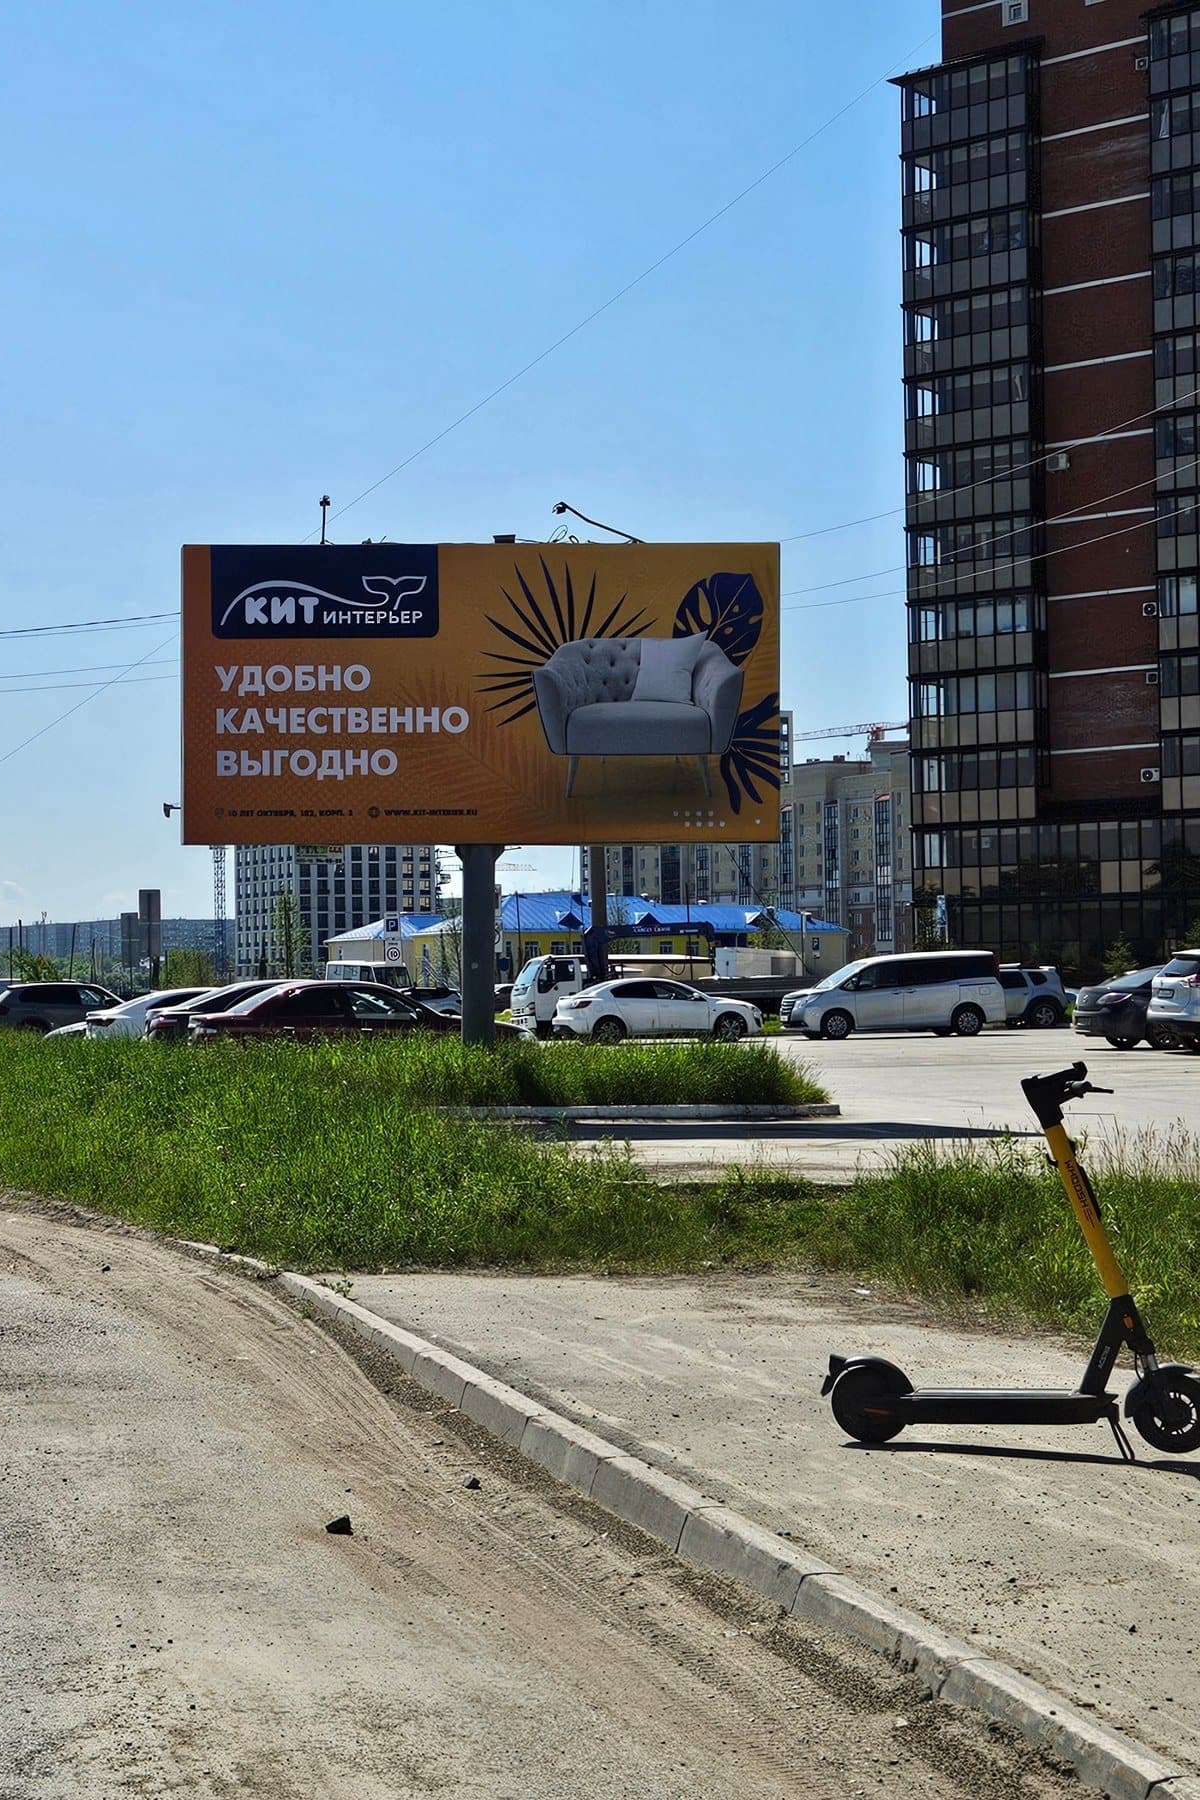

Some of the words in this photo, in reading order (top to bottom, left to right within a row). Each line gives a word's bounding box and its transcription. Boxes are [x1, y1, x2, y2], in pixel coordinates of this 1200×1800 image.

[245, 597, 319, 624] КИТ
[323, 611, 423, 624] ИНТЕРЬЕР
[215, 664, 371, 696] УДОБНО
[216, 706, 469, 734] КАЧЕСТВЕННО
[216, 748, 398, 780] ВЫГОДНО
[1065, 1160, 1088, 1208] WHOOSH
